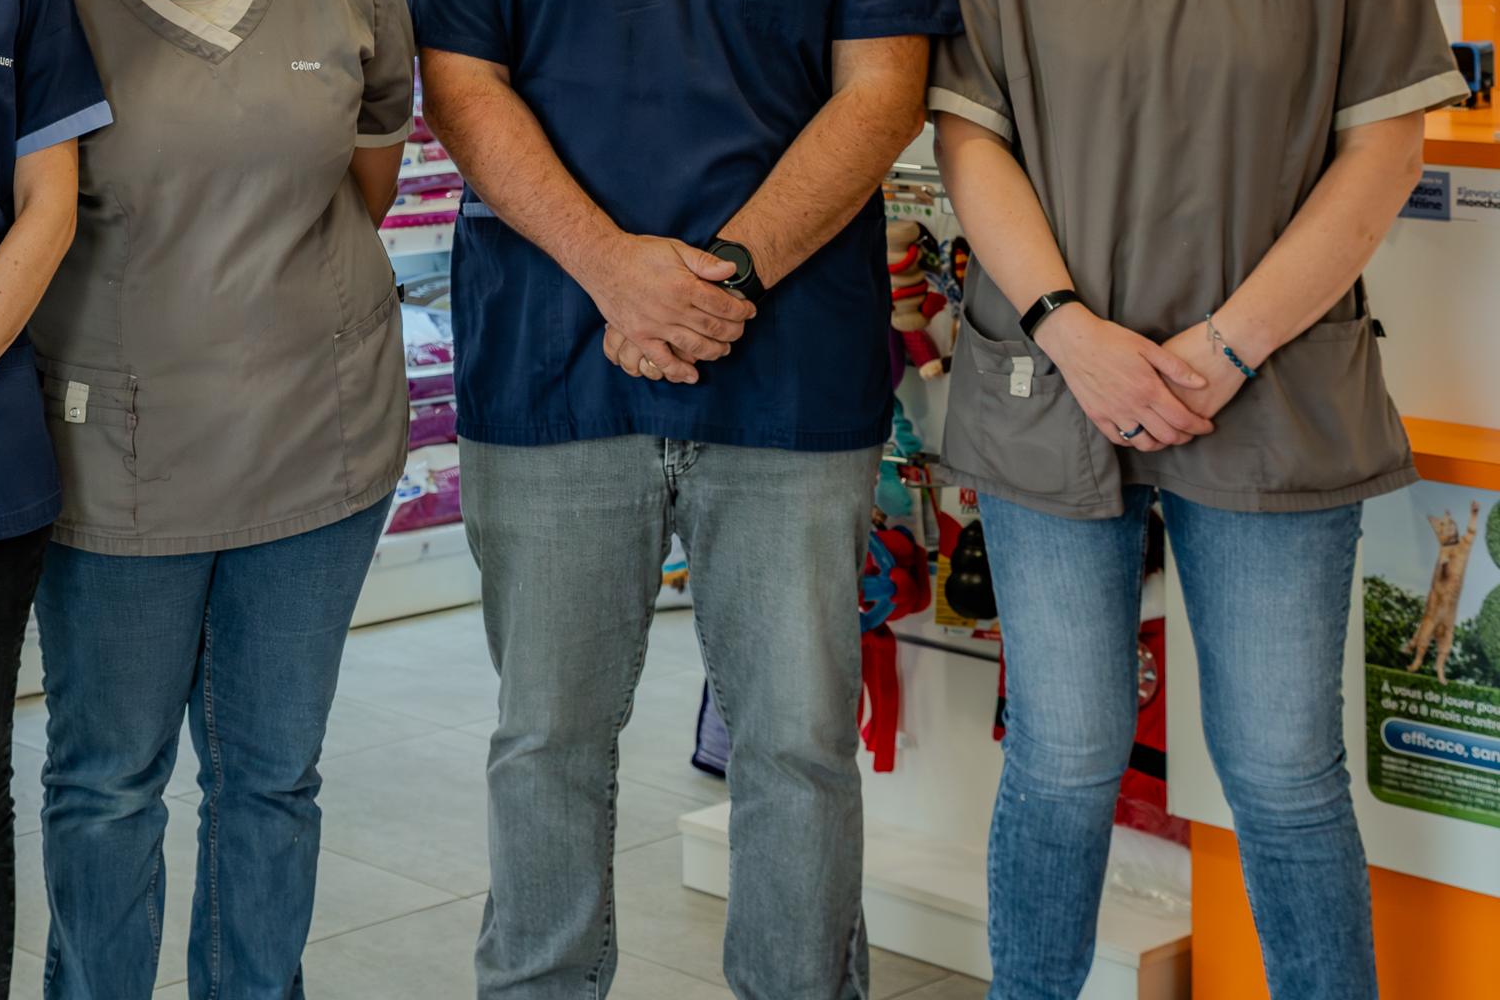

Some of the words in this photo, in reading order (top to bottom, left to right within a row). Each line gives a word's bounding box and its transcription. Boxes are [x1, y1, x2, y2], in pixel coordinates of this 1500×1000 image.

[1381, 697, 1398, 710] de
[1399, 700, 1408, 712] 7
[1430, 707, 1462, 722] mois
[1392, 686, 1422, 699] vous
[1424, 690, 1441, 703] de
[1442, 693, 1475, 709] jouer
[1401, 731, 1469, 758] efficace,
